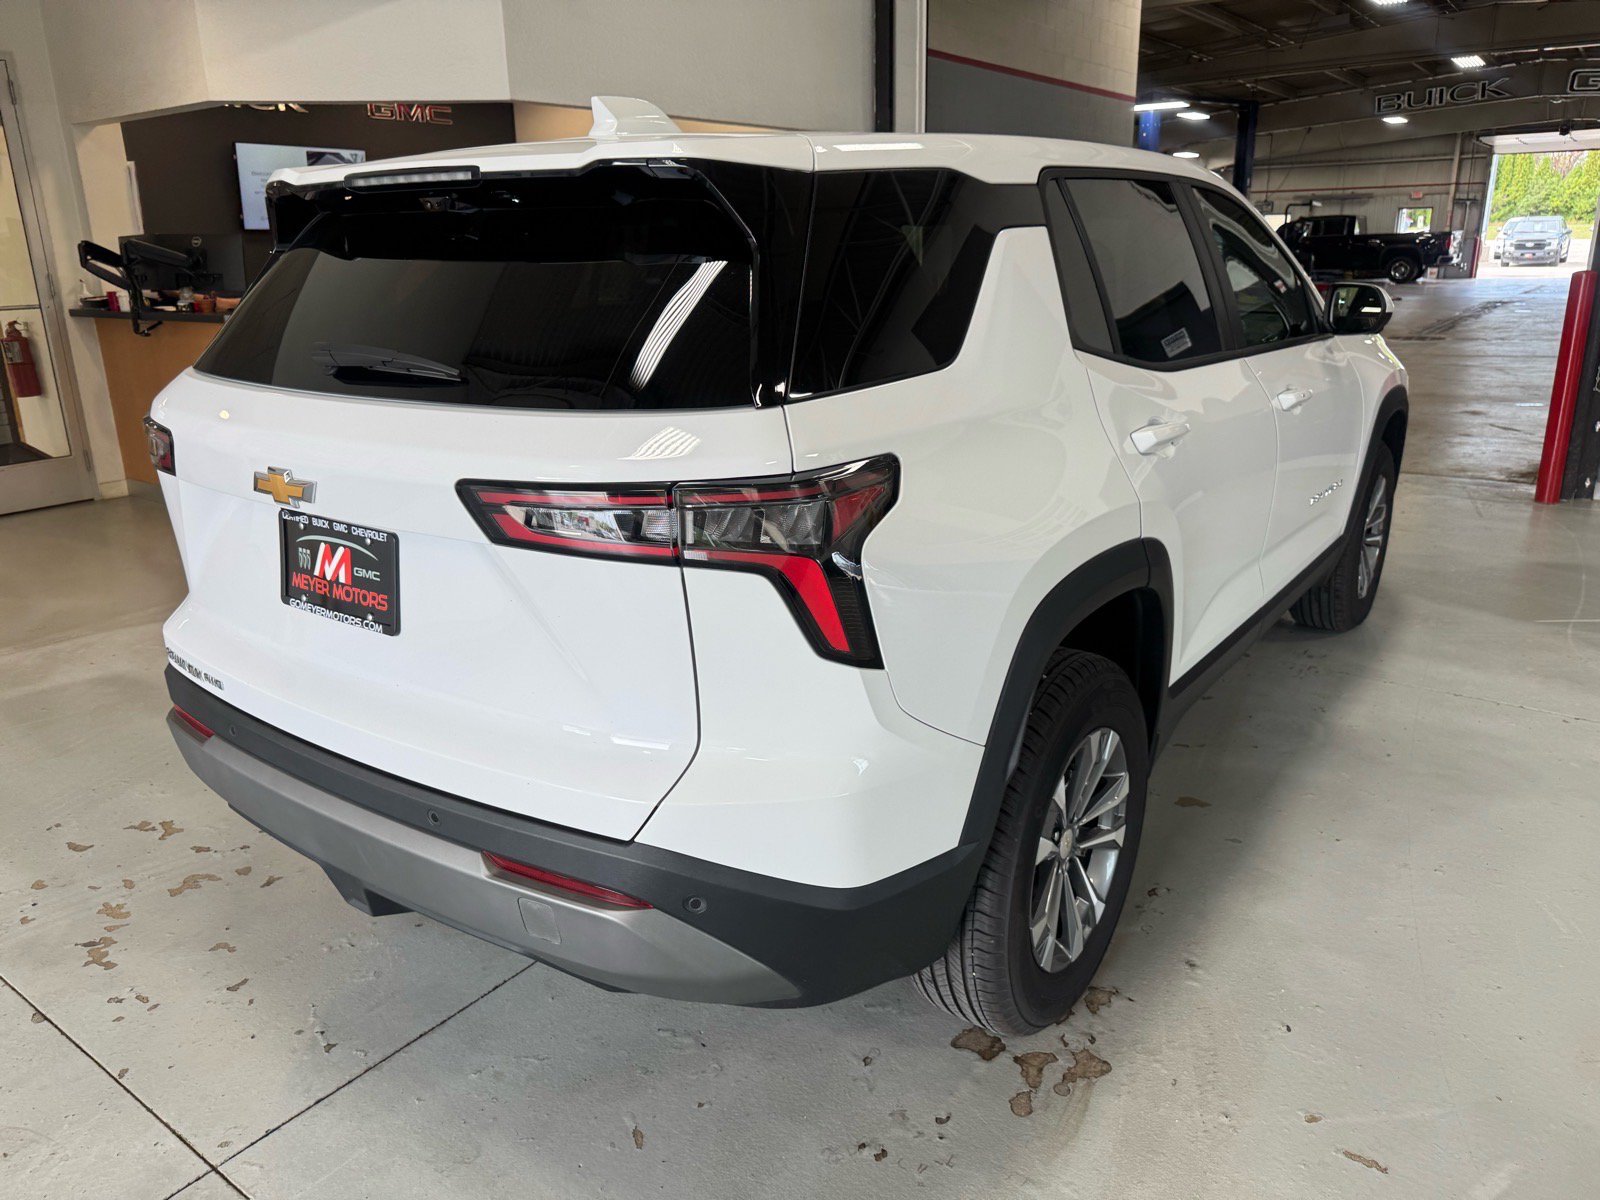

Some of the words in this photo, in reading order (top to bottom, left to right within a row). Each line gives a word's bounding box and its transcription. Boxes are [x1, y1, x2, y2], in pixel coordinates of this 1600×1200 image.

[1374, 77, 1512, 115] BUICK
[366, 102, 454, 126] GMC
[311, 517, 330, 529] BUICK
[332, 522, 348, 534] GMC
[351, 527, 388, 542] CHEVROLET
[353, 567, 381, 581] GMC
[291, 571, 330, 597] MEYER
[332, 583, 389, 612] MOTORS
[289, 598, 383, 634] GOMEYERMOTORS.COM
